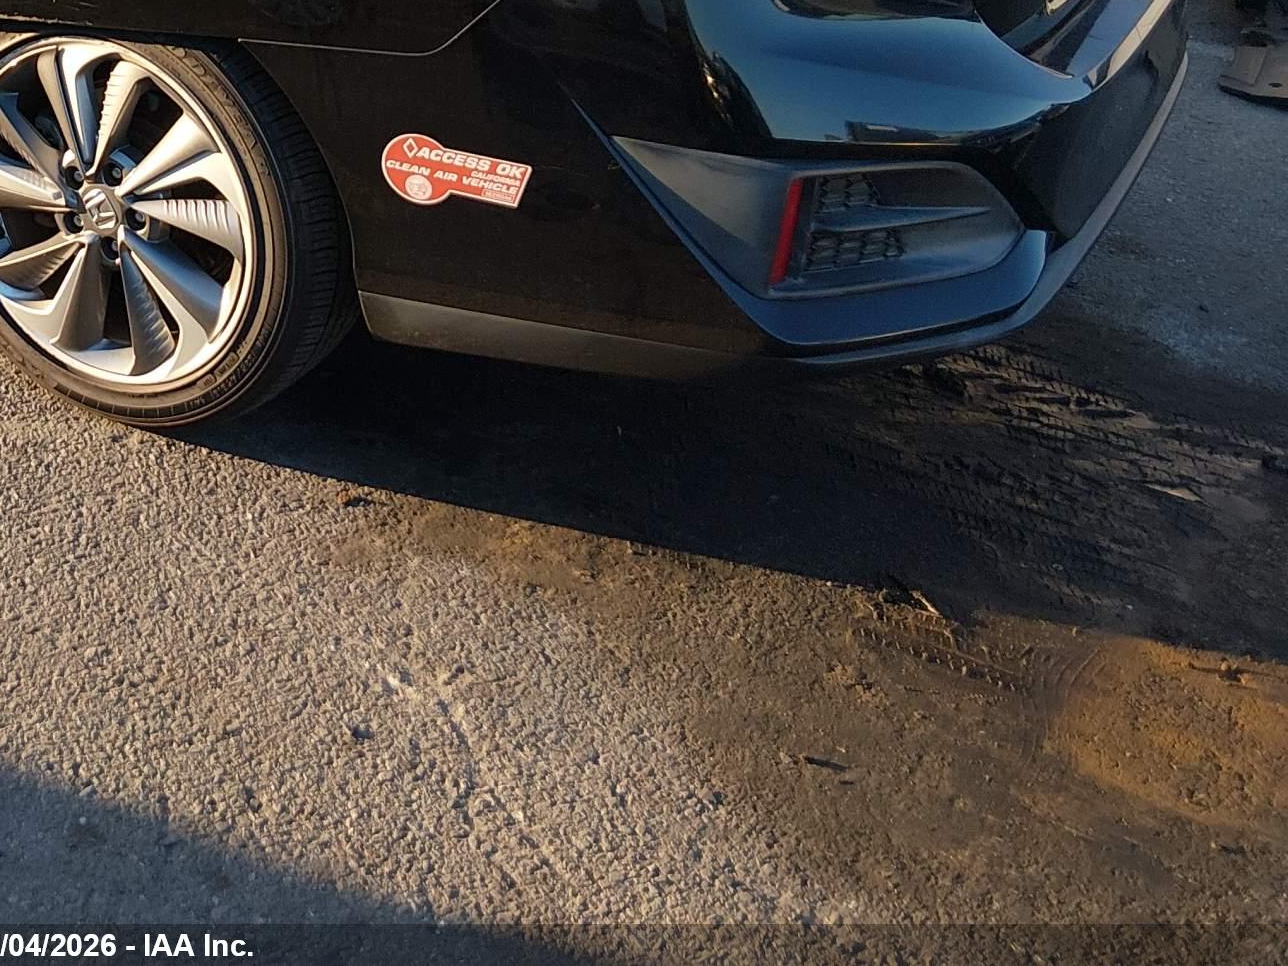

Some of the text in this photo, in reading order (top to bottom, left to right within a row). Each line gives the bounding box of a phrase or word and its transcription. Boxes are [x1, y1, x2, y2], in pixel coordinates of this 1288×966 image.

[385, 159, 520, 195] CLEAN AIR VEHICLE
[415, 146, 526, 180] ACCESS OK
[470, 170, 521, 187] CALIFORNIA
